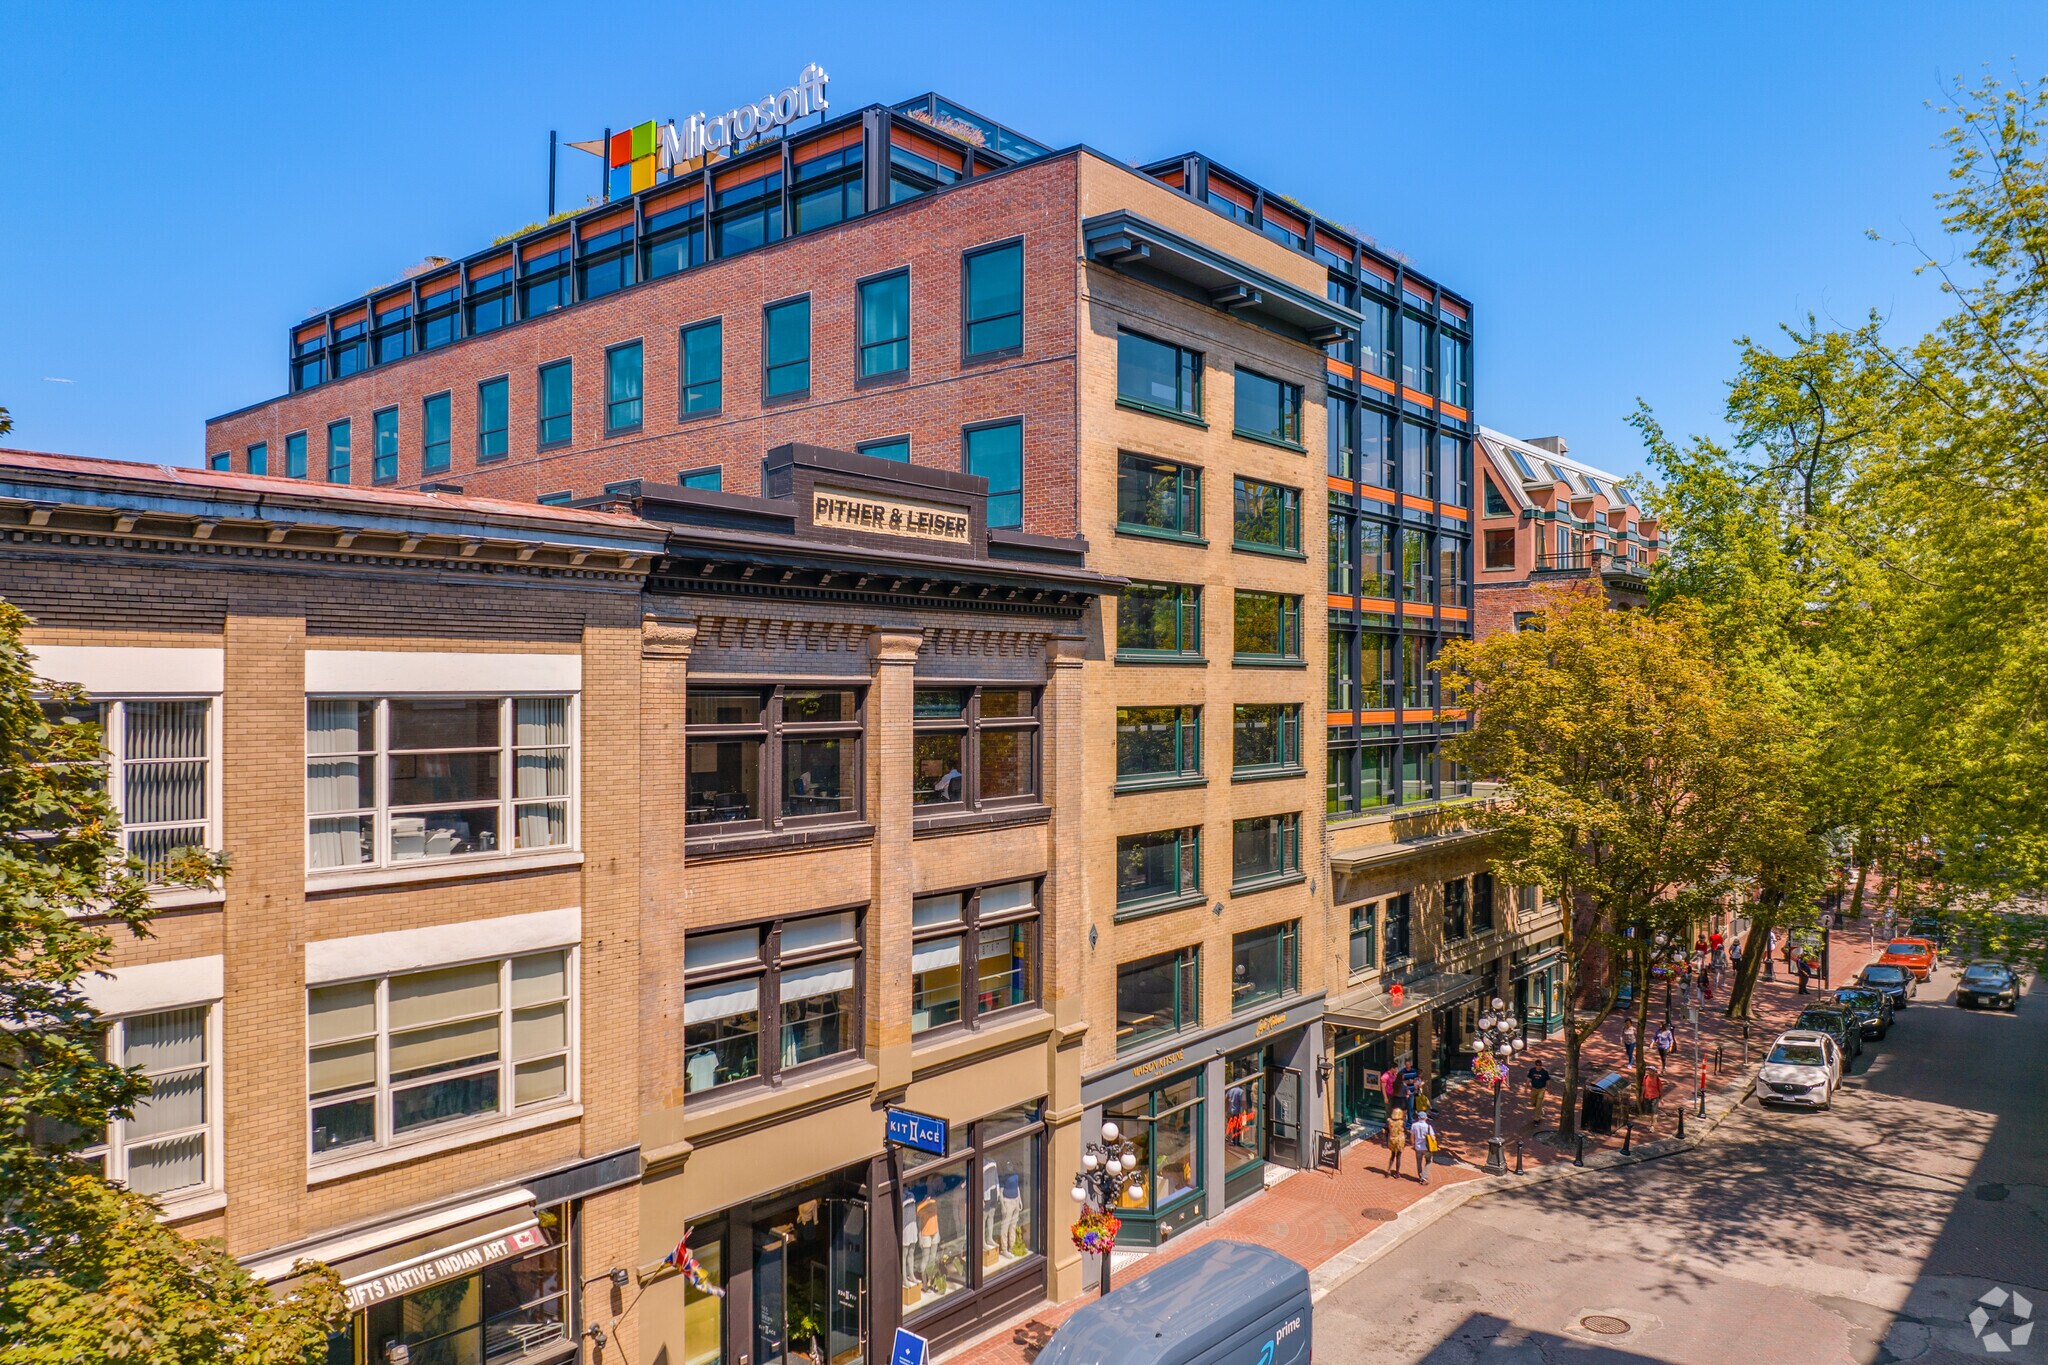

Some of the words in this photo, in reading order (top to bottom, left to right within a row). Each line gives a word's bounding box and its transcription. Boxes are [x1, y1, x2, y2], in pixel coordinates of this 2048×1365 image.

[662, 62, 830, 169] Microsoft
[815, 497, 885, 525] PITHER
[889, 508, 902, 527] &
[907, 510, 967, 534] LEISER
[890, 1120, 908, 1134] KIT
[919, 1130, 940, 1143] ACE
[344, 1280, 386, 1309] GIFTS
[384, 1262, 437, 1294] NATIVE
[434, 1247, 484, 1277] INDIAN
[482, 1239, 509, 1262] ART
[1276, 1316, 1301, 1346] prime
